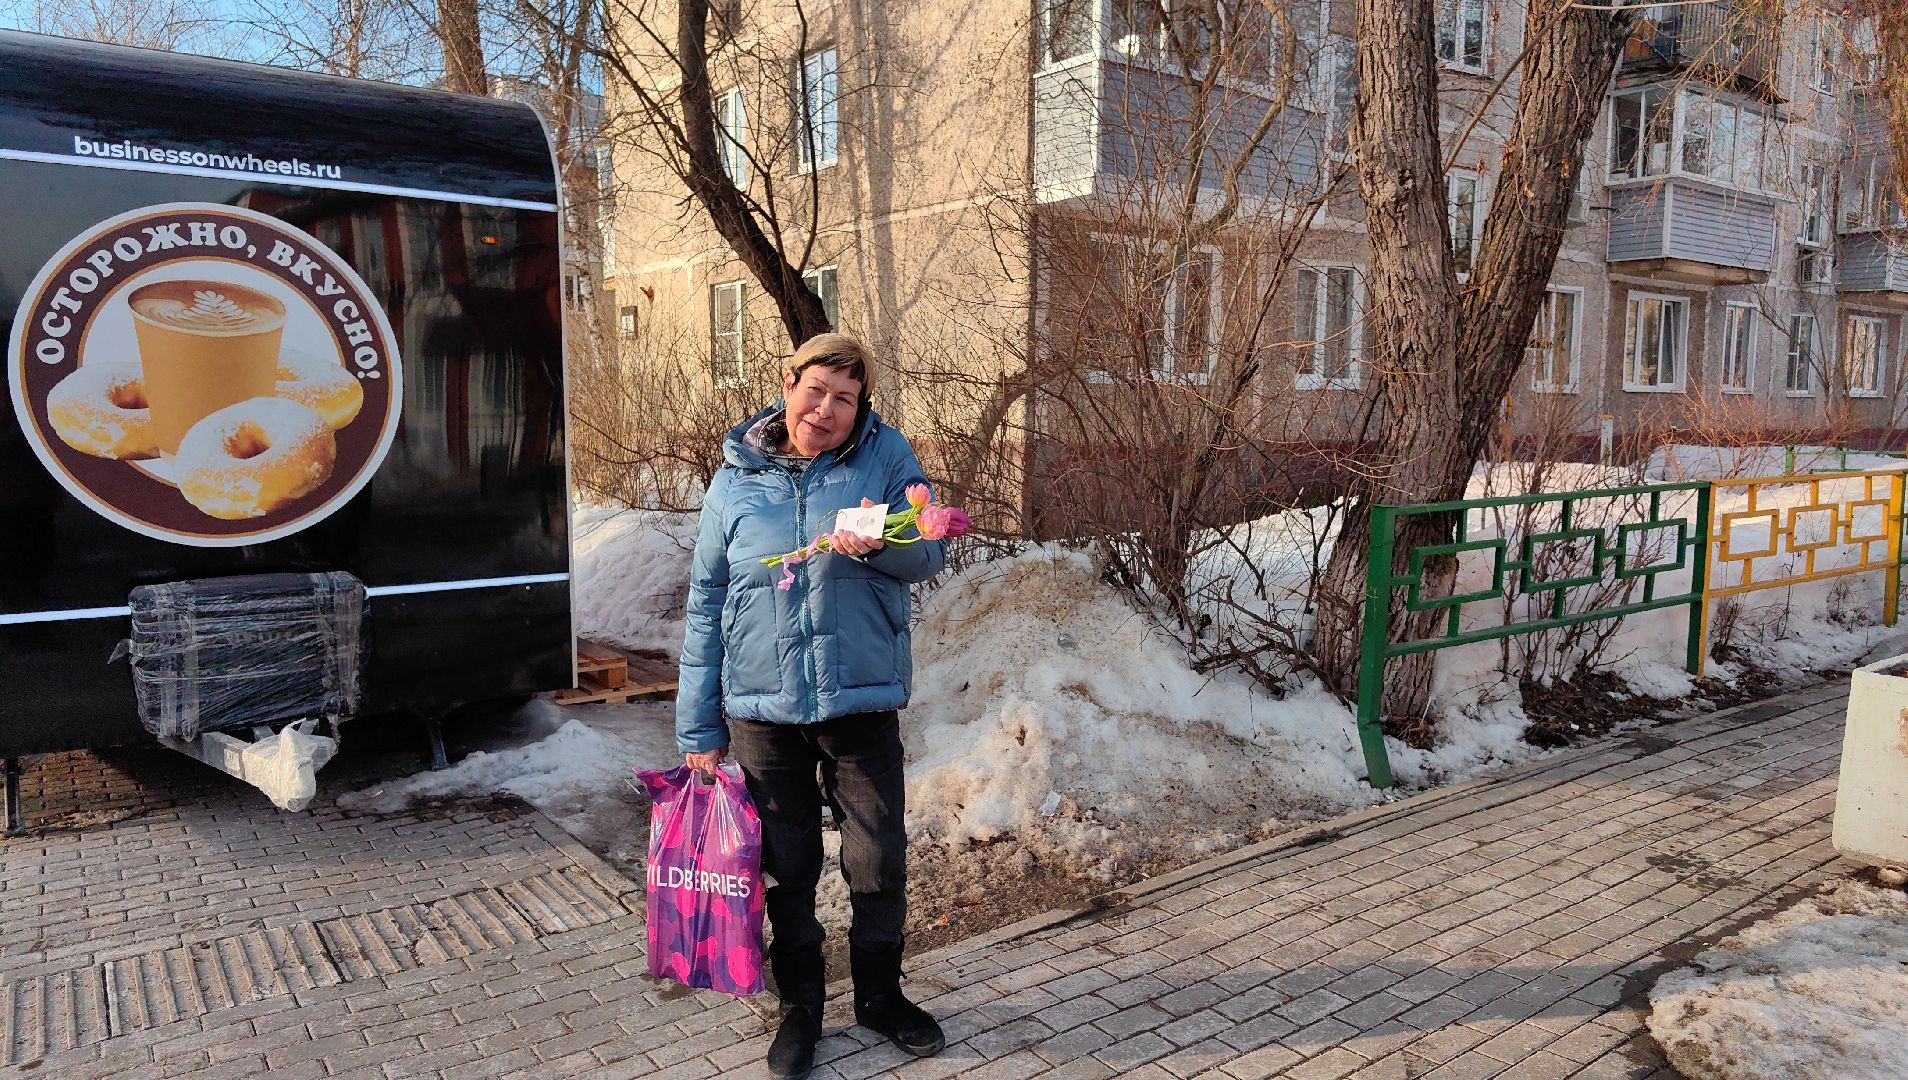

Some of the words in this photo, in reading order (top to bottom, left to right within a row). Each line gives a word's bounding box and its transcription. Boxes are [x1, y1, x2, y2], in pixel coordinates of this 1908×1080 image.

[74, 135, 342, 179] businessonwheels.ru
[35, 221, 258, 365] ОСТОРОЖНО,
[266, 239, 381, 380] ВКУСНО!
[647, 863, 751, 898] ILDBERRIES
